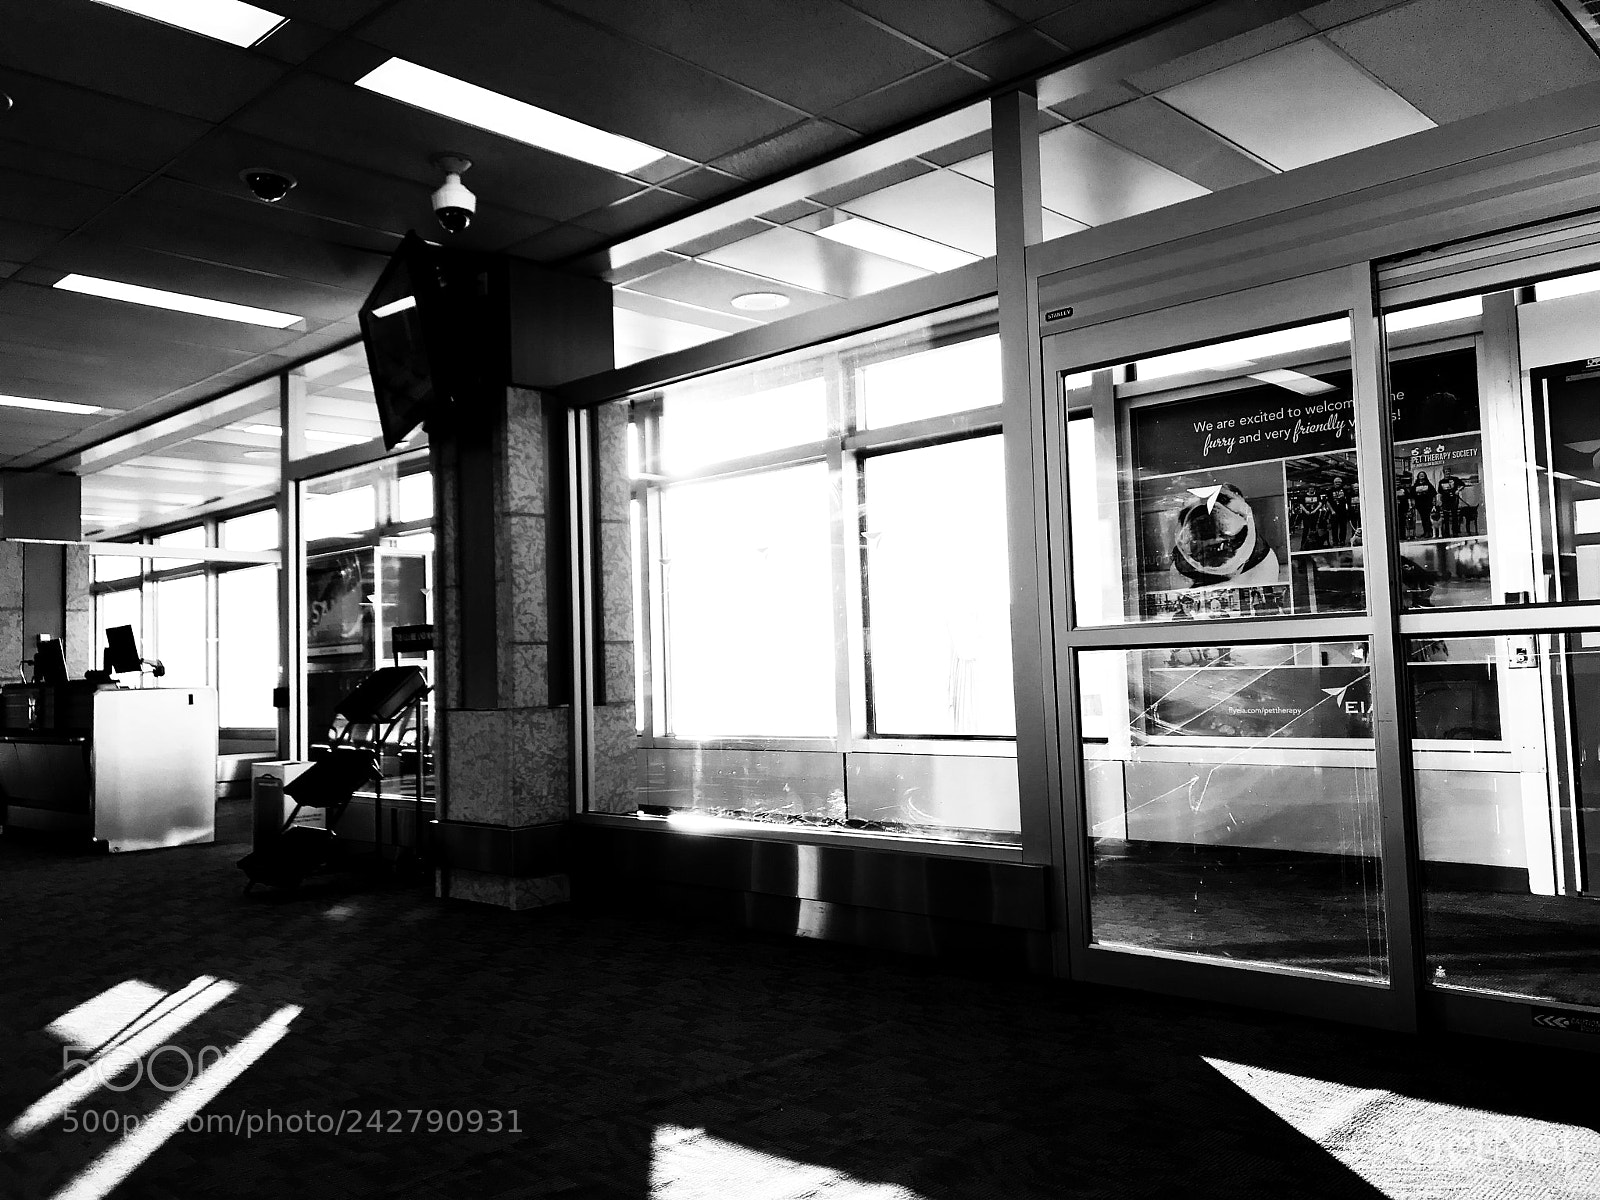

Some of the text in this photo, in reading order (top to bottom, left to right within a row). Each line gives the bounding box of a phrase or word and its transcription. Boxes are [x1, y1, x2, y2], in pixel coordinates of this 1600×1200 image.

[1047, 309, 1071, 320] STANLEY
[1193, 421, 1214, 433] We
[1216, 419, 1235, 430] are
[1239, 407, 1284, 426] excited
[1287, 407, 1301, 418] to
[1203, 433, 1236, 457] furry
[1239, 429, 1261, 444] and
[1264, 428, 1291, 441] very
[1292, 413, 1346, 444] friendly
[1411, 448, 1478, 464] PET THERAPY SOCIETY
